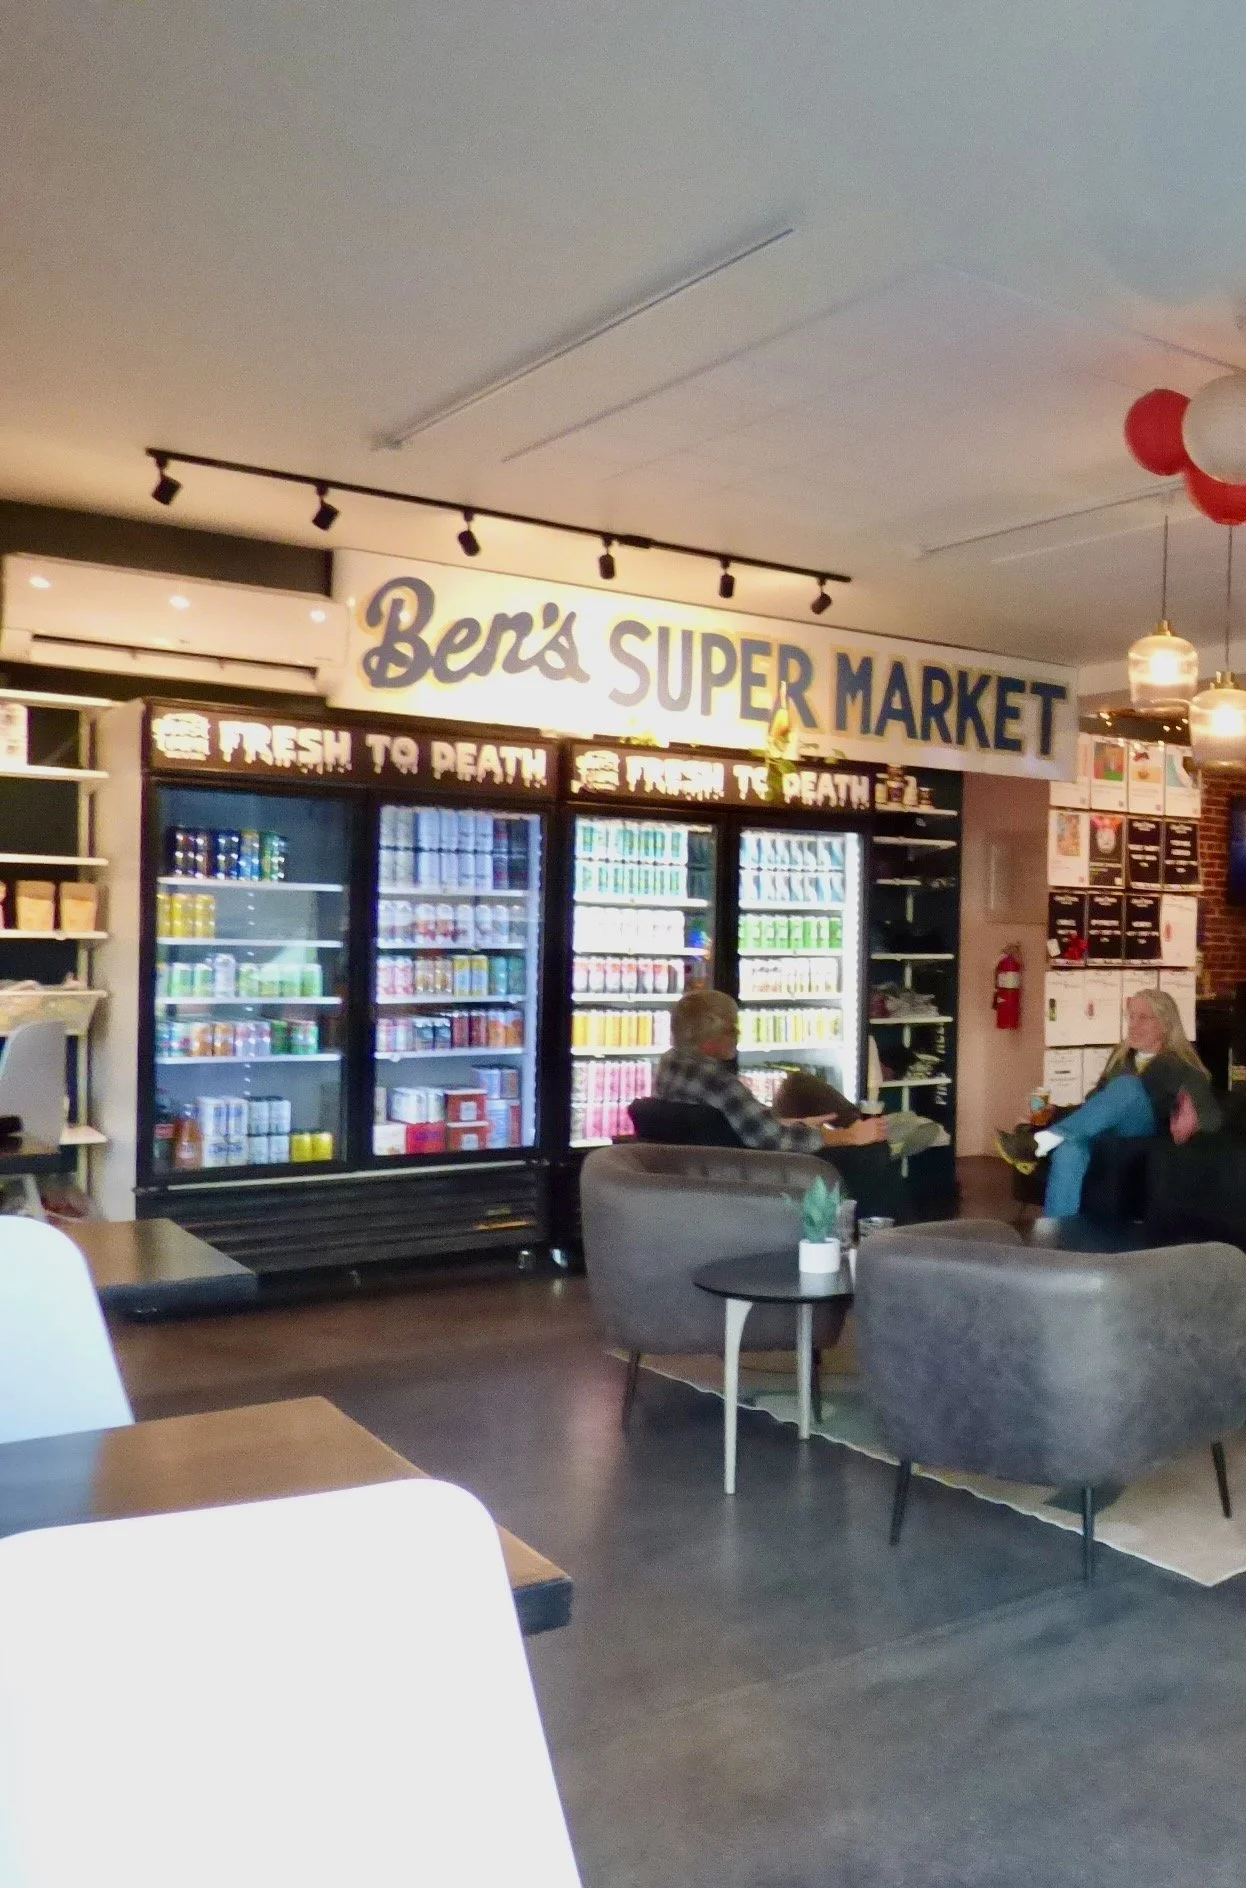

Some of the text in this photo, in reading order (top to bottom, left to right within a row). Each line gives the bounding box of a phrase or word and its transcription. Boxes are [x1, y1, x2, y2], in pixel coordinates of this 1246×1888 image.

[364, 576, 1067, 757] Ben's SUPER MARKET
[218, 720, 547, 788] FRESH TO DEATH
[625, 755, 725, 801] FRESH
[782, 770, 870, 810] DEATH
